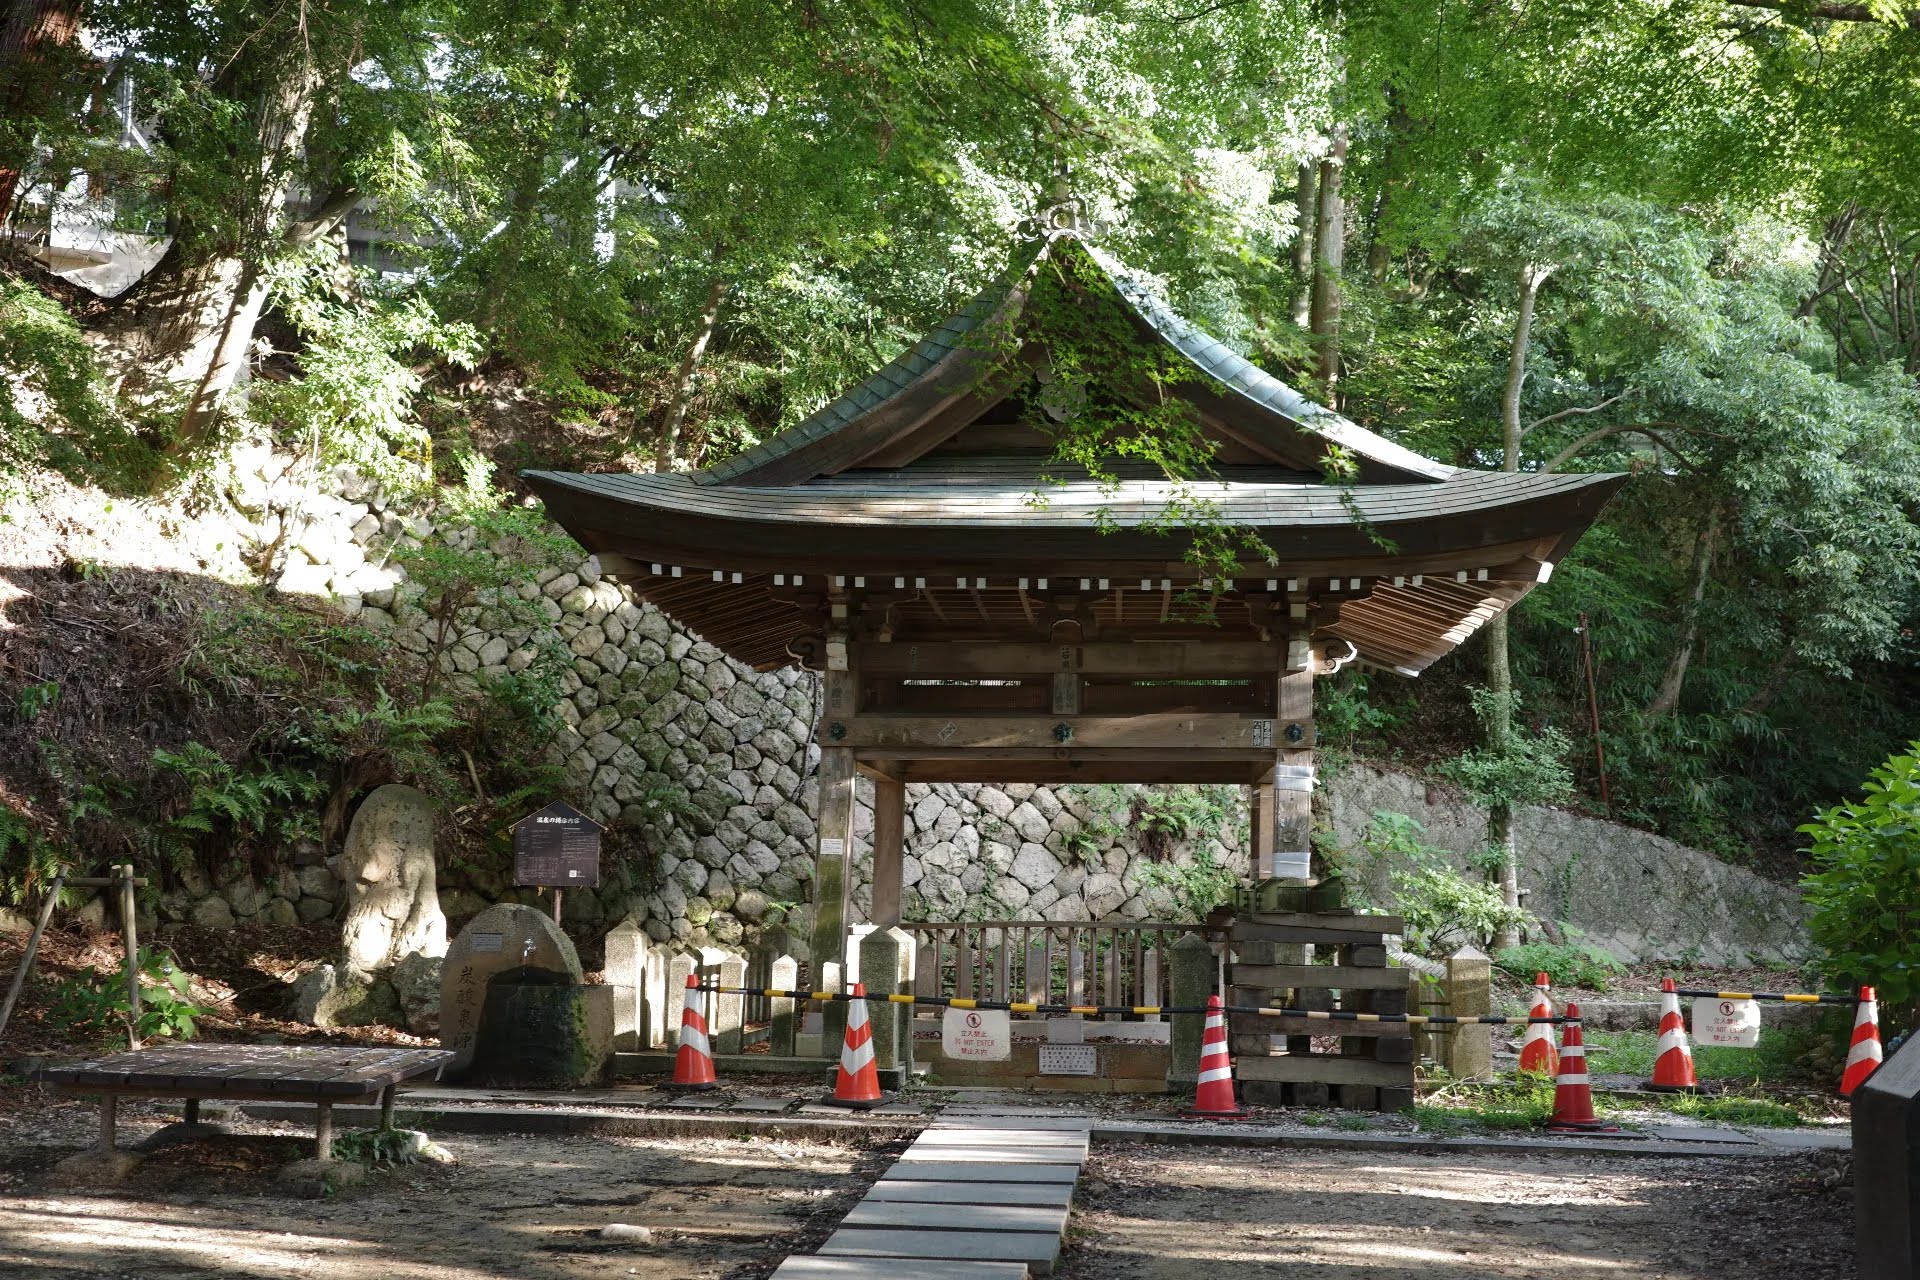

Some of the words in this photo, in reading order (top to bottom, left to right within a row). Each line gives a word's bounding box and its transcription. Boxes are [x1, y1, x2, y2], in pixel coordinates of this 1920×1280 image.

[454, 966, 477, 1048] 炭酸泉源
[1714, 1017, 1739, 1025] 立入禁止
[961, 1048, 987, 1056] 禁止入内
